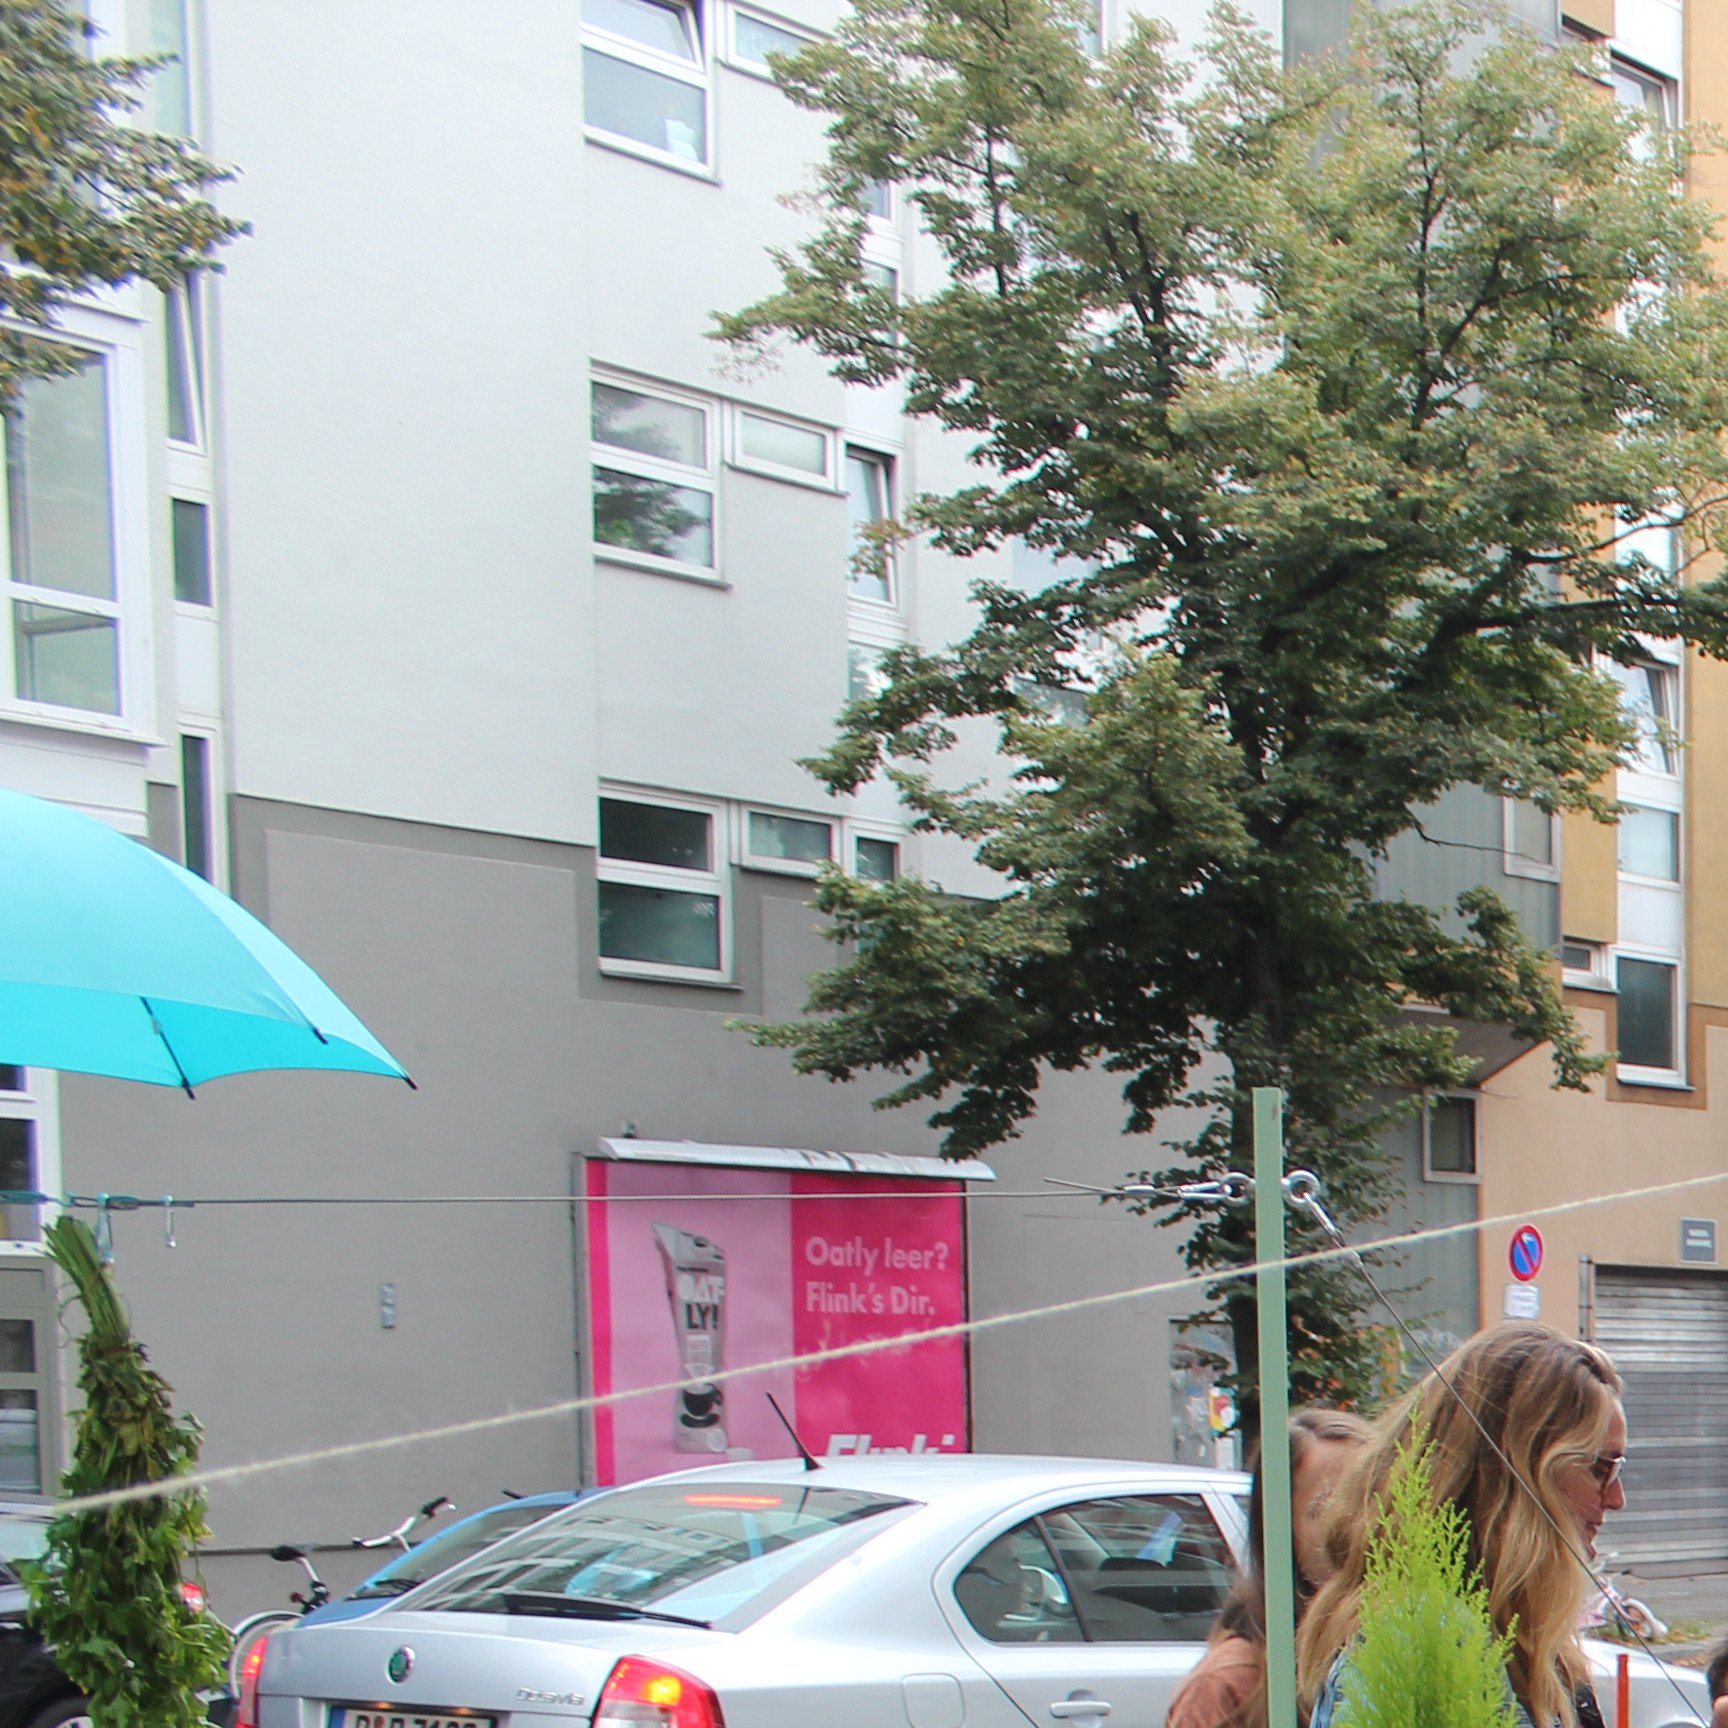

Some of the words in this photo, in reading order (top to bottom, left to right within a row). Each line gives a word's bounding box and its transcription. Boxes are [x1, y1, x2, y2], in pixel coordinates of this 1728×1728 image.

[804, 1235, 879, 1277] Oatly
[883, 1237, 950, 1271] leer?
[685, 1302, 720, 1330] LY!
[805, 1280, 885, 1314] Flink's
[890, 1284, 937, 1316] Dir.
